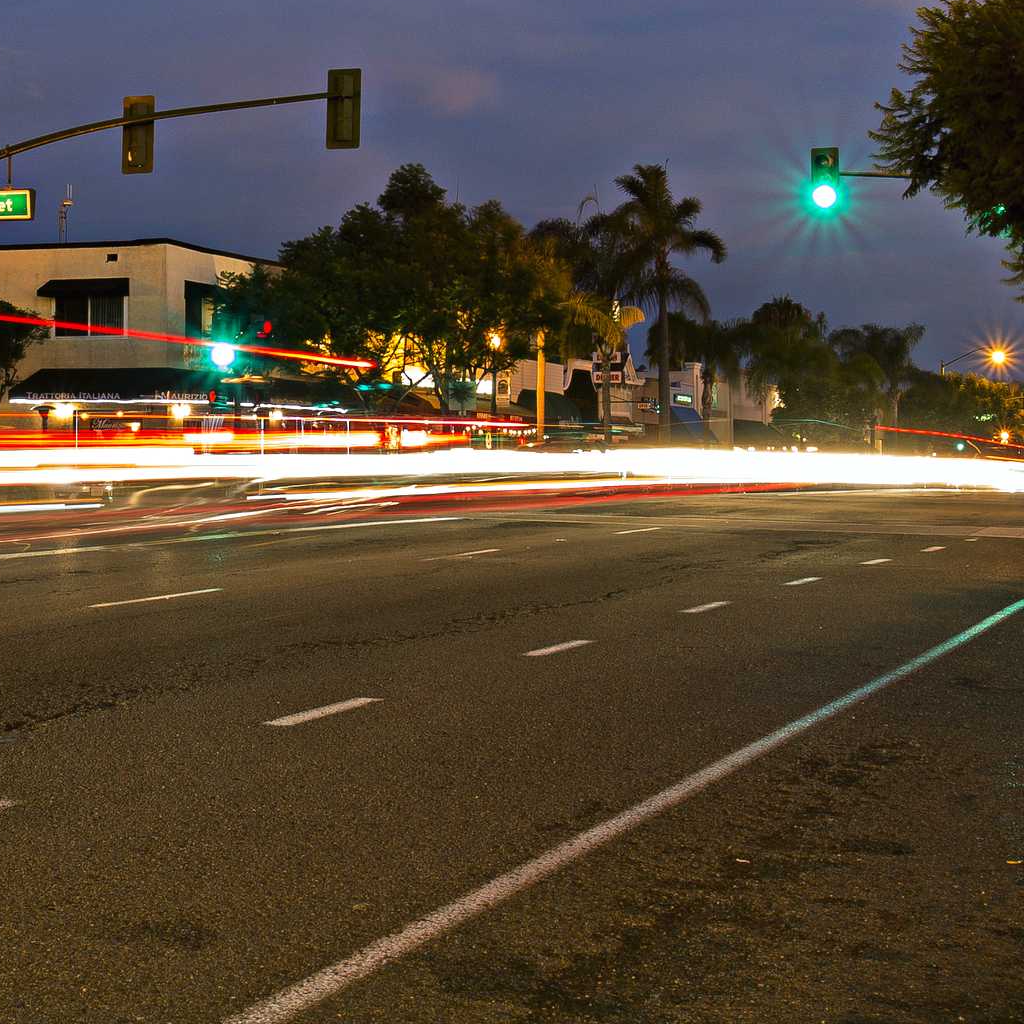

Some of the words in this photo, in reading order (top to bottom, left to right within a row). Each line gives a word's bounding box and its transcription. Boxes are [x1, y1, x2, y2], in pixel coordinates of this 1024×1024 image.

[26, 391, 76, 400] TRATTORIA
[78, 391, 121, 400] ITALIANA
[160, 390, 208, 400] MAURIZIO
